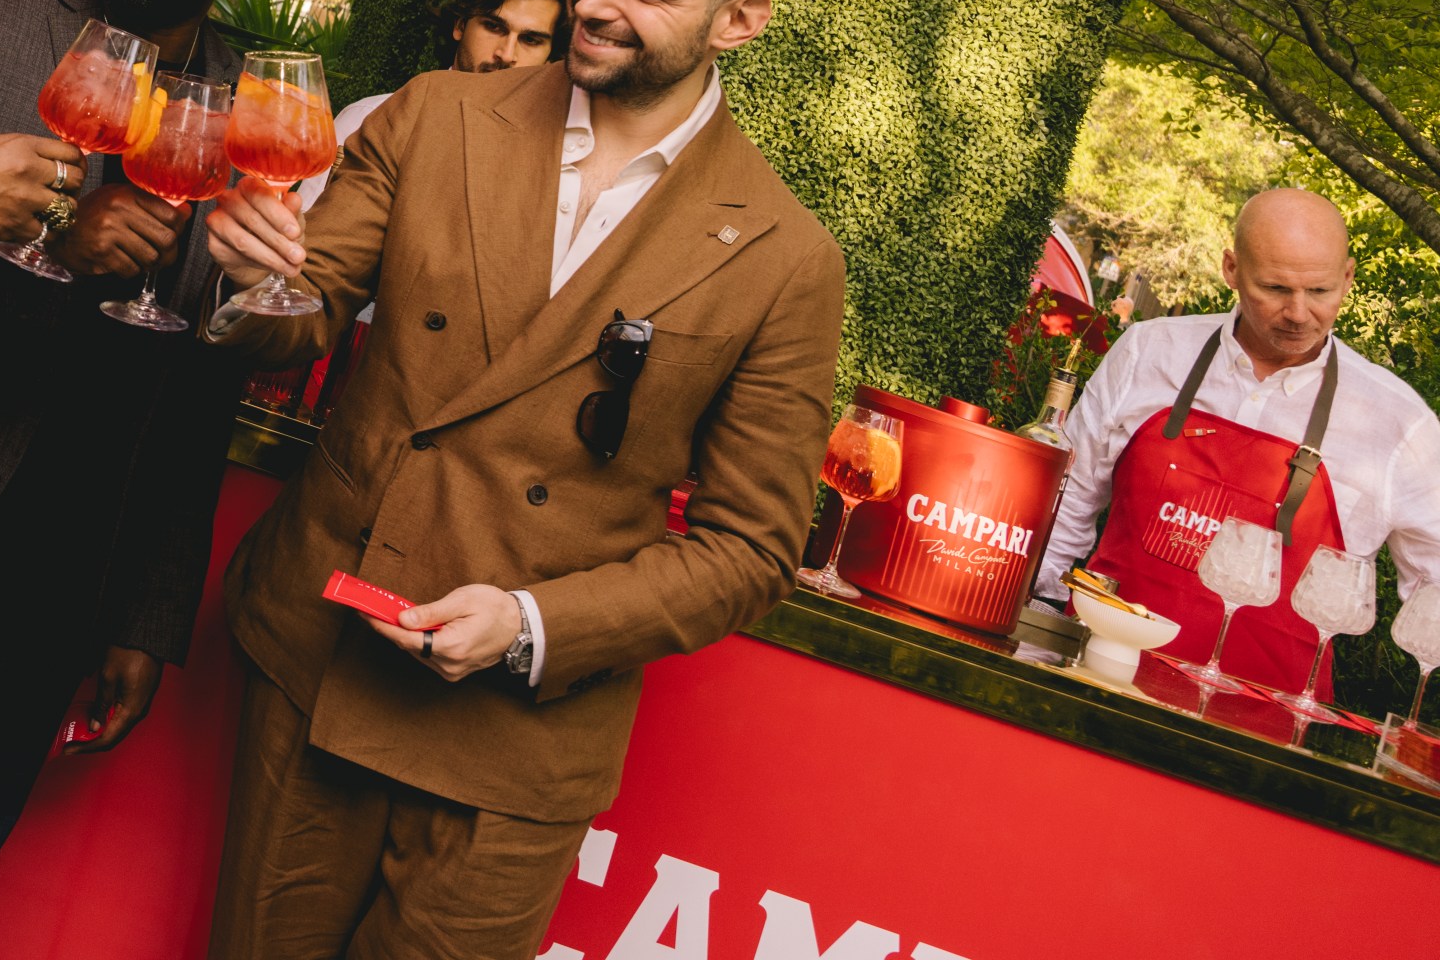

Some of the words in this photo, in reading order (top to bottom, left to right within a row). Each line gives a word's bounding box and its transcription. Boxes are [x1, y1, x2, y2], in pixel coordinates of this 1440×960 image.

[906, 493, 1033, 556] CAMPARI
[1159, 501, 1221, 536] CAMP
[919, 538, 968, 559] Davide
[1171, 541, 1200, 557] MILA
[932, 554, 995, 580] MILANO
